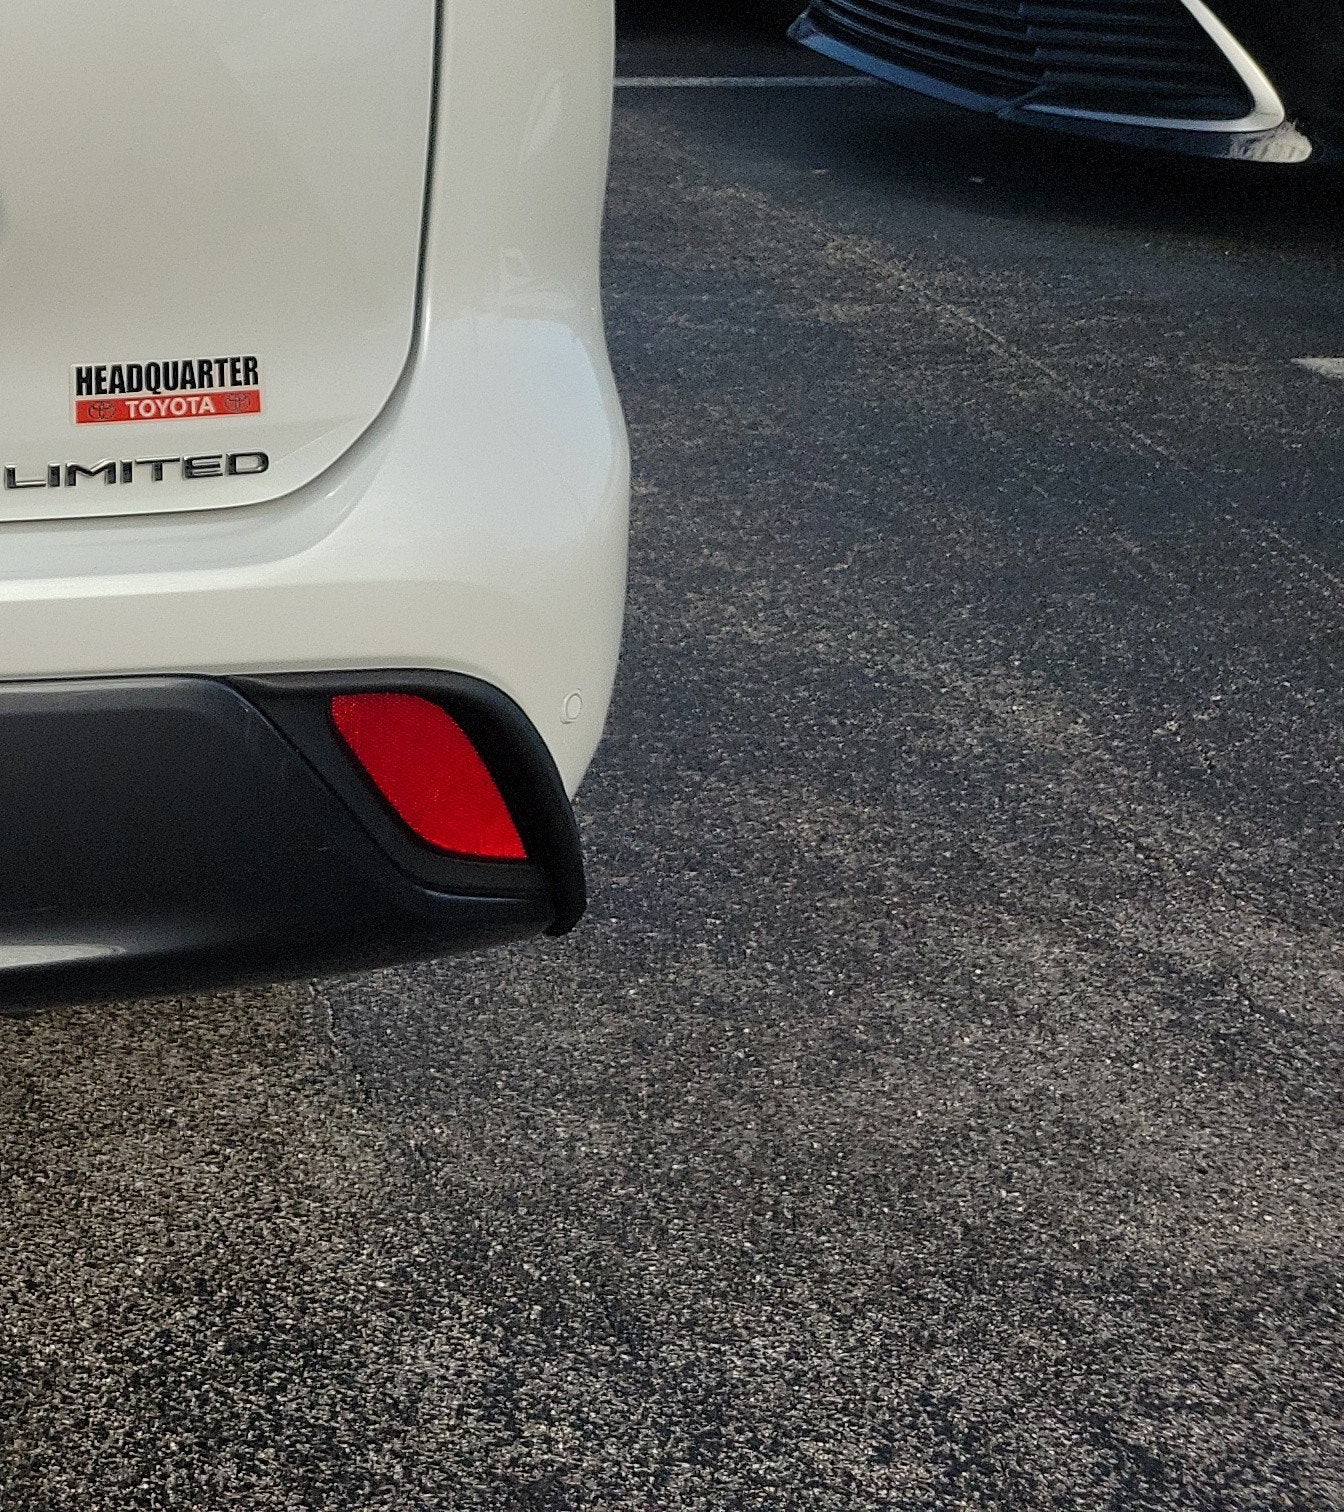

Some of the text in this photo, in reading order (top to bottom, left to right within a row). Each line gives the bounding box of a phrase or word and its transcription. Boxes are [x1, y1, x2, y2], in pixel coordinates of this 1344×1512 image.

[75, 355, 259, 396] HEADQUARTER
[124, 396, 216, 419] TOYOTA
[4, 450, 270, 490] LIMITED
